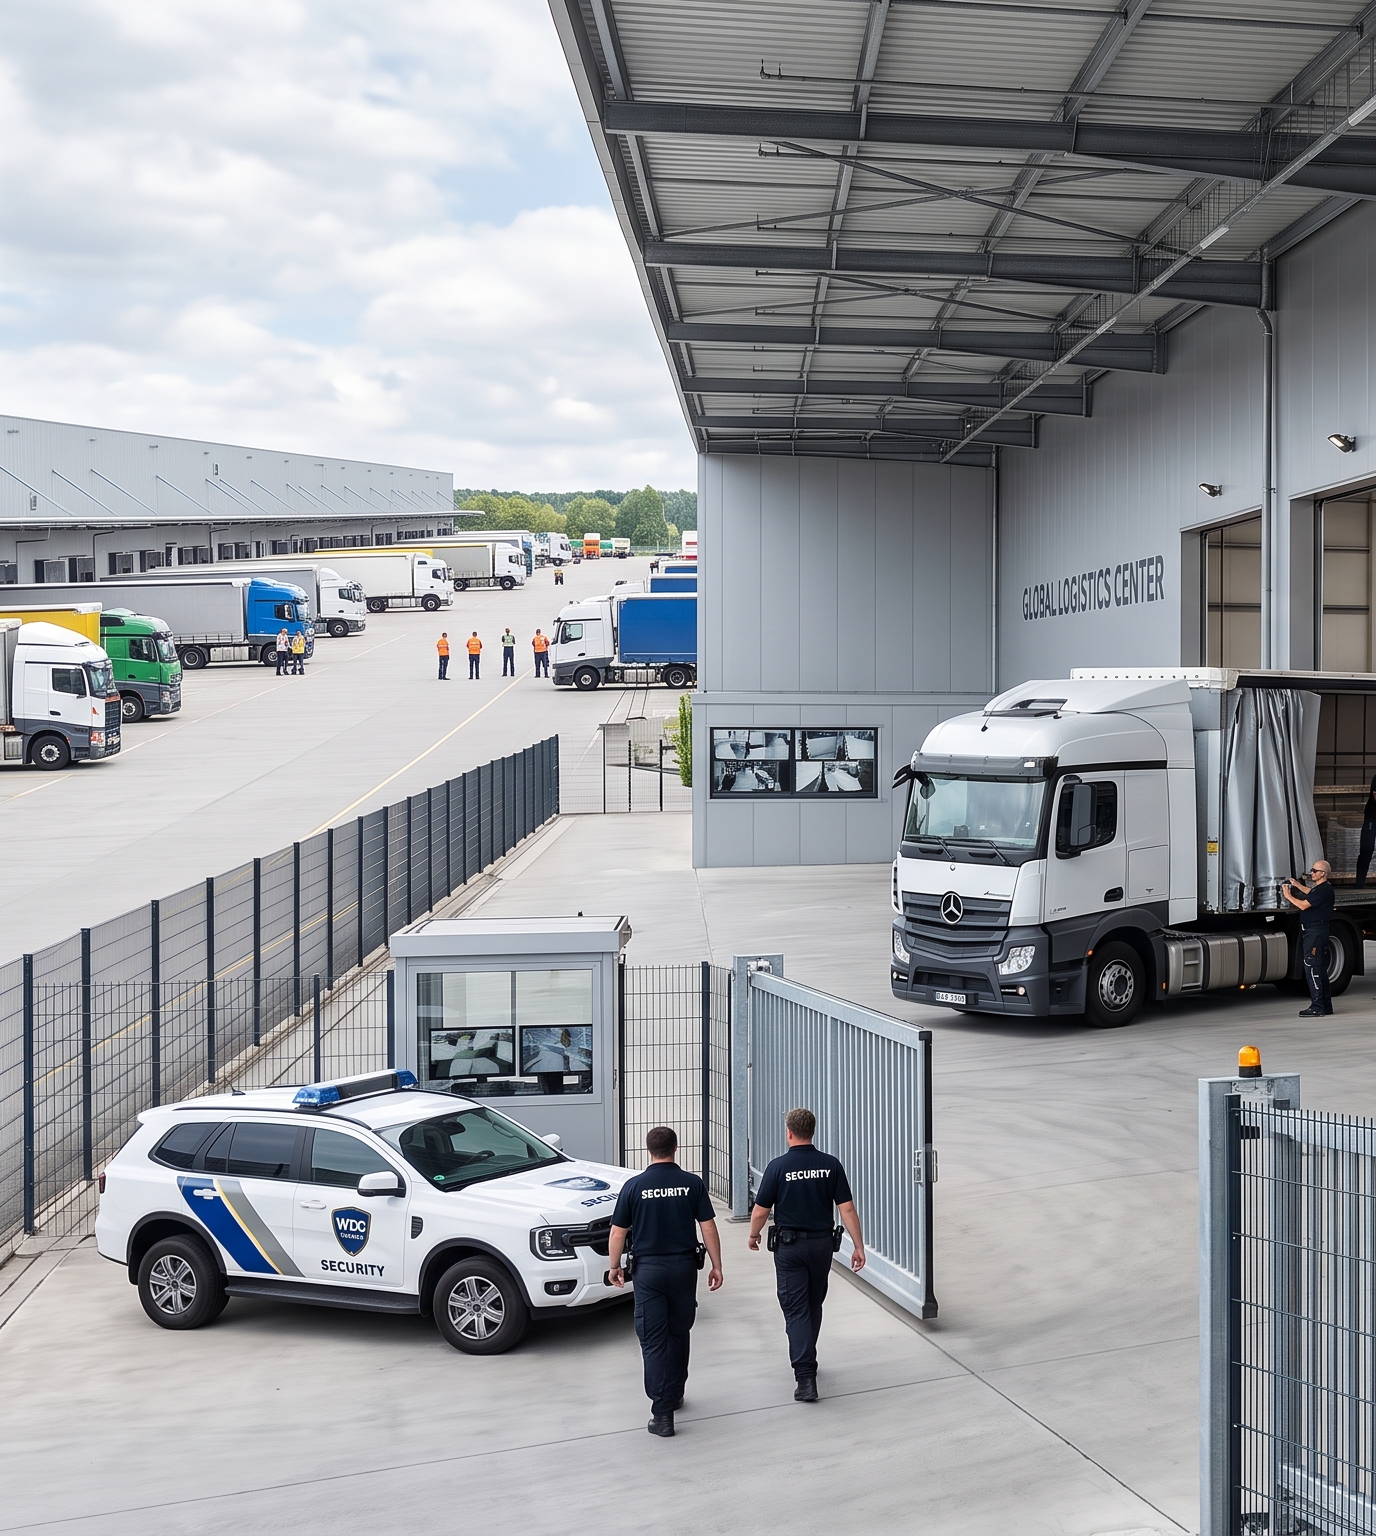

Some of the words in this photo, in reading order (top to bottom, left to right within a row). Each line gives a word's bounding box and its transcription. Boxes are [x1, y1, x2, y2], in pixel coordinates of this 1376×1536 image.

[1022, 582, 1057, 621] GLOBAL
[1058, 567, 1112, 616] LOGISTICS
[1114, 555, 1165, 607] CENTER
[785, 1169, 831, 1182] SECURITY
[641, 1187, 690, 1199] SECURITY
[336, 1217, 366, 1233] WDC
[321, 1259, 385, 1277] SECURITY
